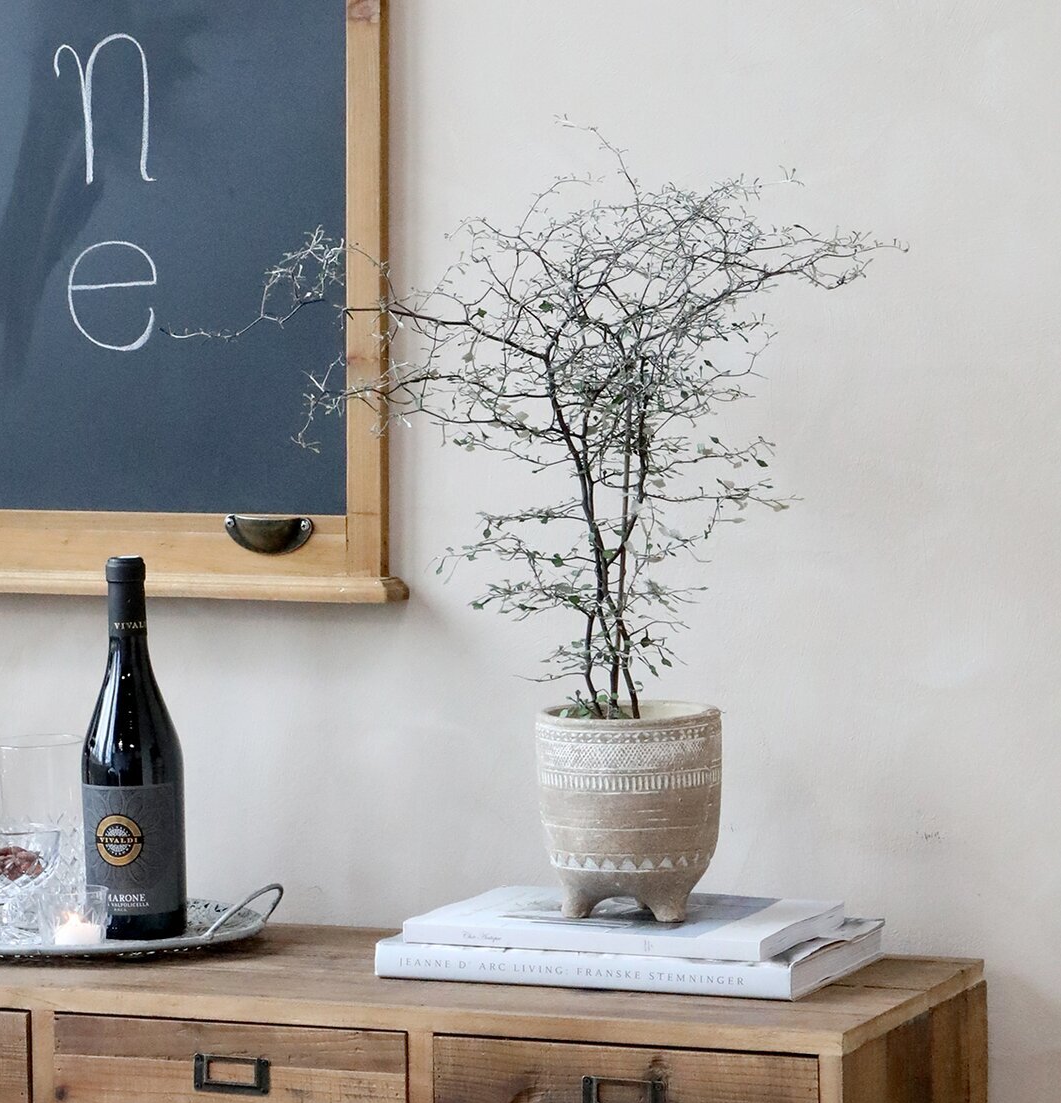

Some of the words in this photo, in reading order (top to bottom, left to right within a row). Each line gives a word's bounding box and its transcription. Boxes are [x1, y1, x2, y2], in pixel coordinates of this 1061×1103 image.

[399, 957, 451, 968] JEANNE
[478, 962, 506, 971] ARC
[513, 964, 569, 975] LIVING:
[576, 967, 641, 979] FRANSKE
[648, 971, 745, 986] STEMNINGER
